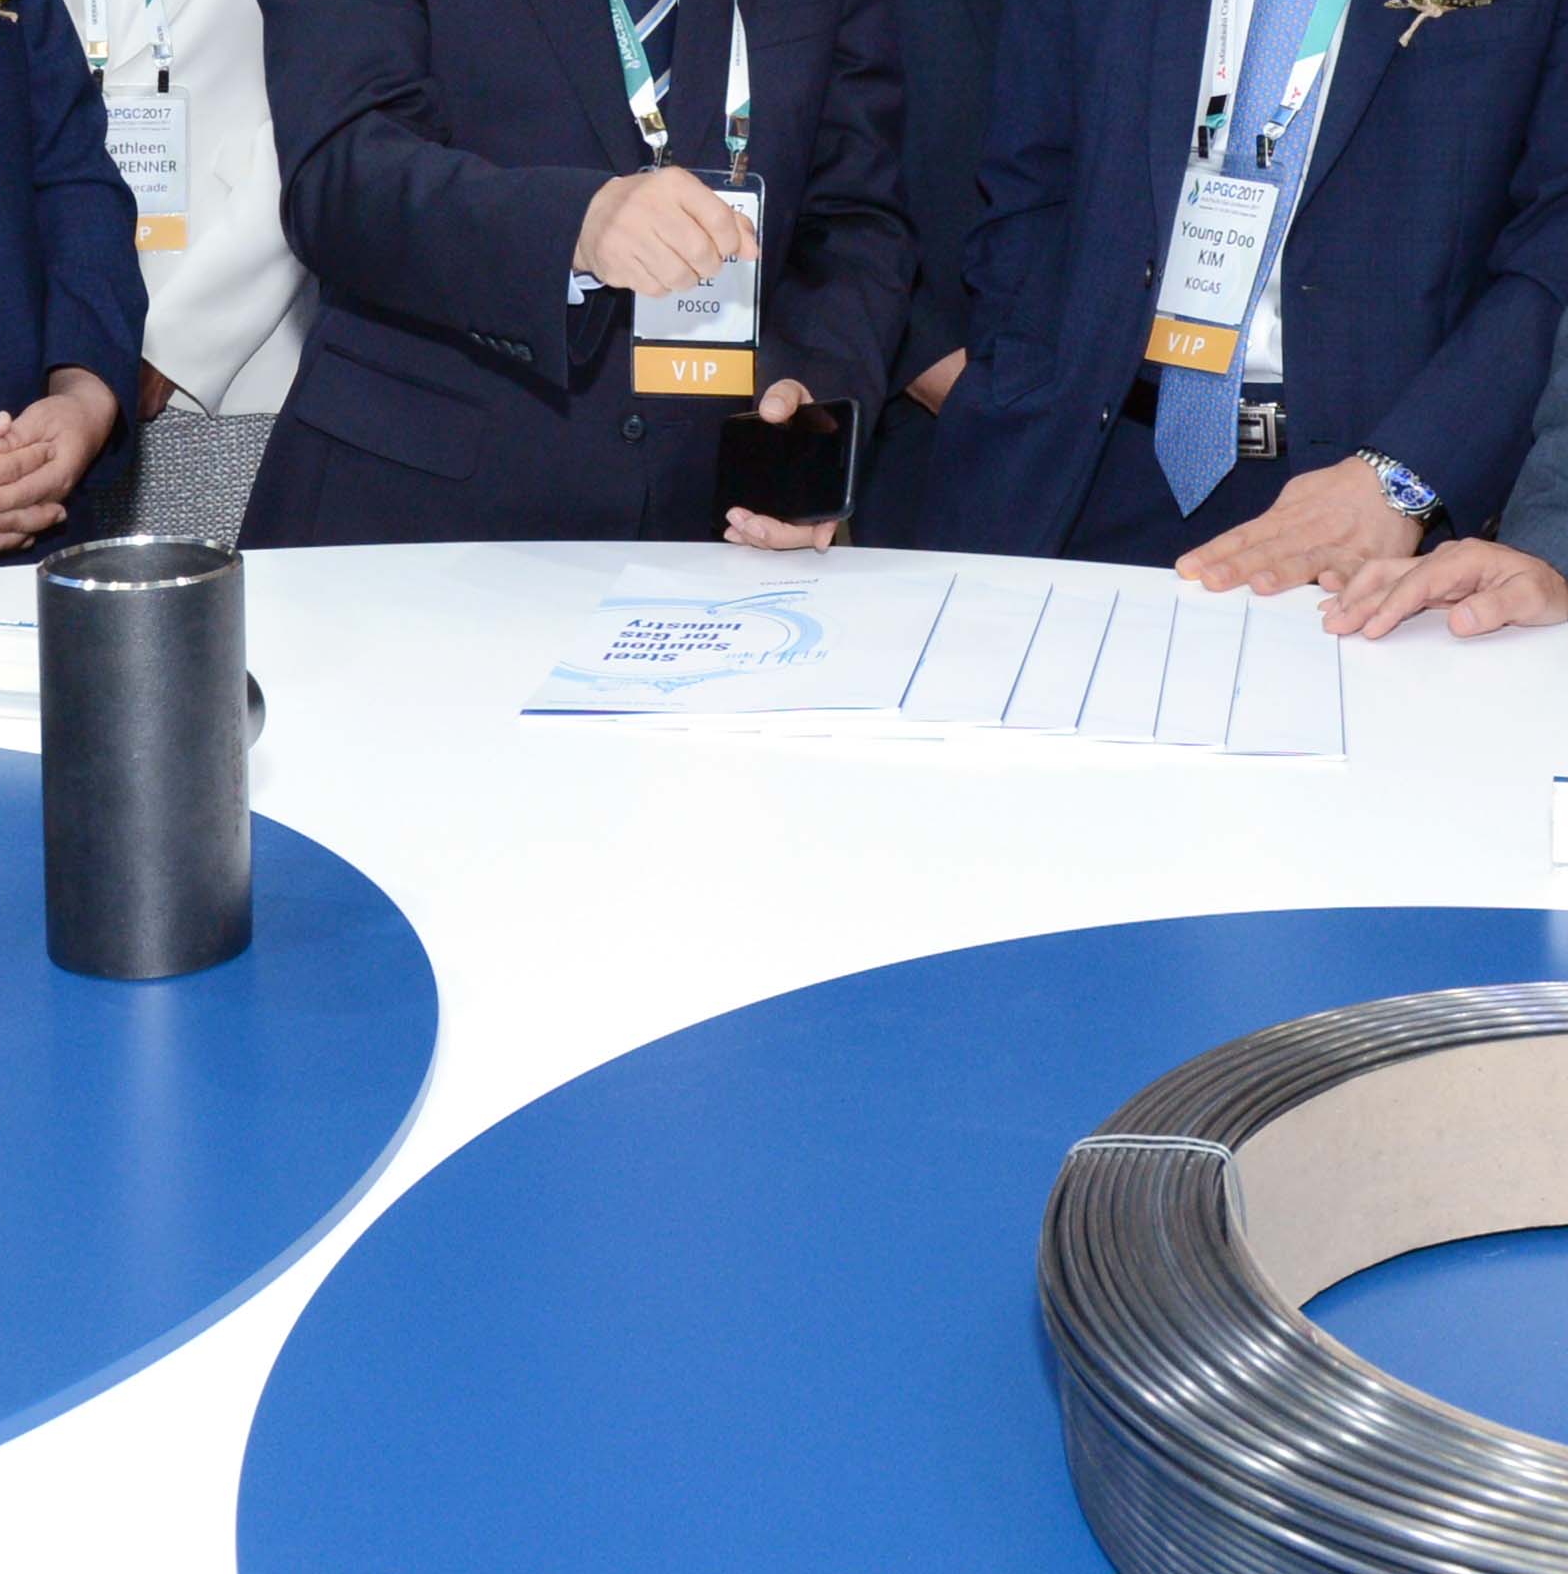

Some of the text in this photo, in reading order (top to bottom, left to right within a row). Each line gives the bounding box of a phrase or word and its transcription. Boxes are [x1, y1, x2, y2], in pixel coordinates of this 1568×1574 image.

[119, 160, 177, 173] RENNER
[133, 183, 168, 193] ecade
[1203, 180, 1264, 203] APGC2017
[1181, 221, 1255, 248] Young Doo
[1198, 249, 1225, 268] KIM
[1185, 277, 1222, 294] KOGAS
[677, 299, 720, 313] POSCO
[1167, 332, 1205, 355] VIP
[672, 360, 718, 381] VIP
[626, 619, 743, 631] Industry
[620, 631, 720, 641] for Gas
[612, 641, 731, 652] Solution
[603, 652, 678, 662] Steel
